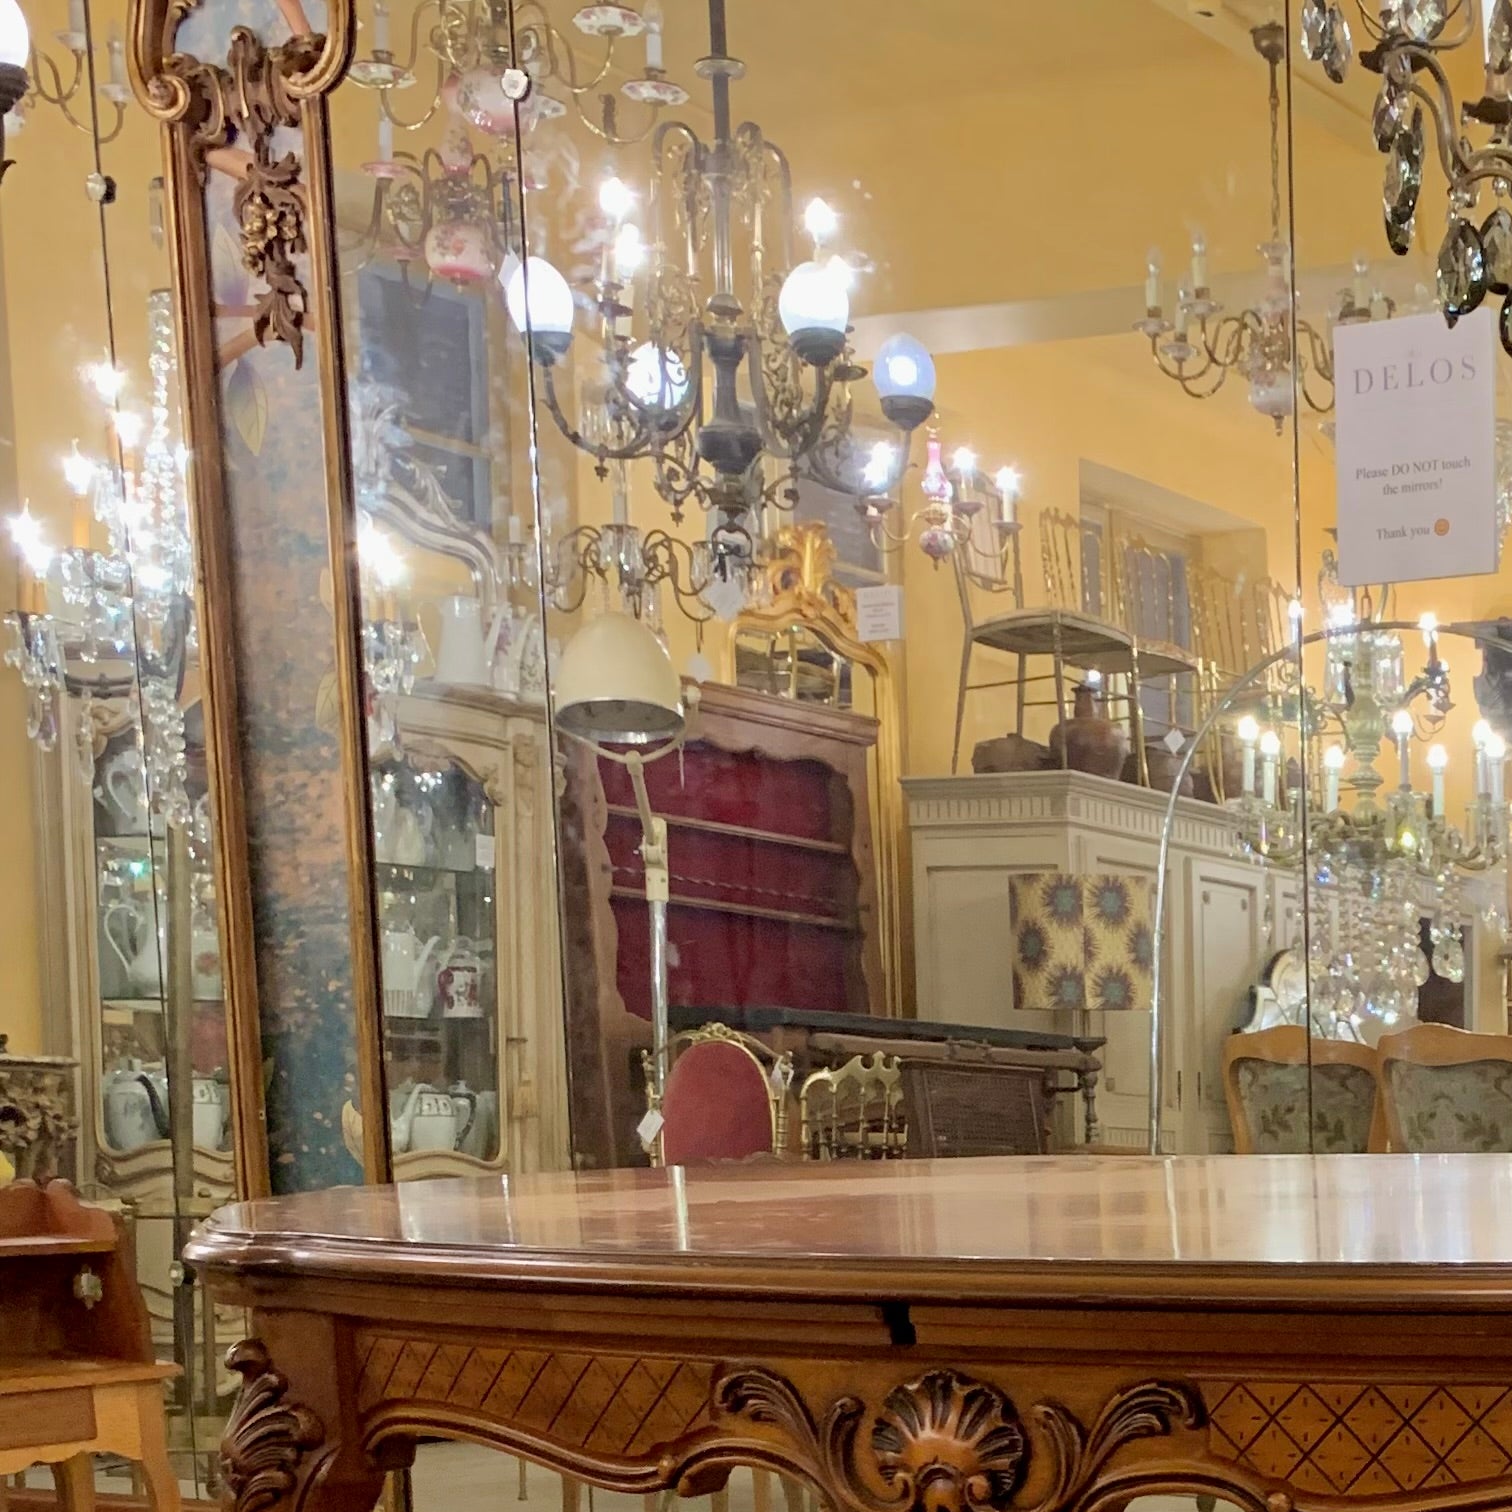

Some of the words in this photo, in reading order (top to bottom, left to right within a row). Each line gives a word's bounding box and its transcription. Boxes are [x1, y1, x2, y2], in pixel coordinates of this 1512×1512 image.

[1353, 355, 1477, 395] DELOS
[1355, 464, 1389, 481] Please
[1391, 461, 1410, 477] DO
[1413, 459, 1440, 475] NOT
[1441, 456, 1471, 472] touch
[1382, 483, 1399, 496] the
[1400, 478, 1443, 494] mirrors!
[1376, 525, 1407, 541] Thank
[1410, 526, 1430, 539] you
